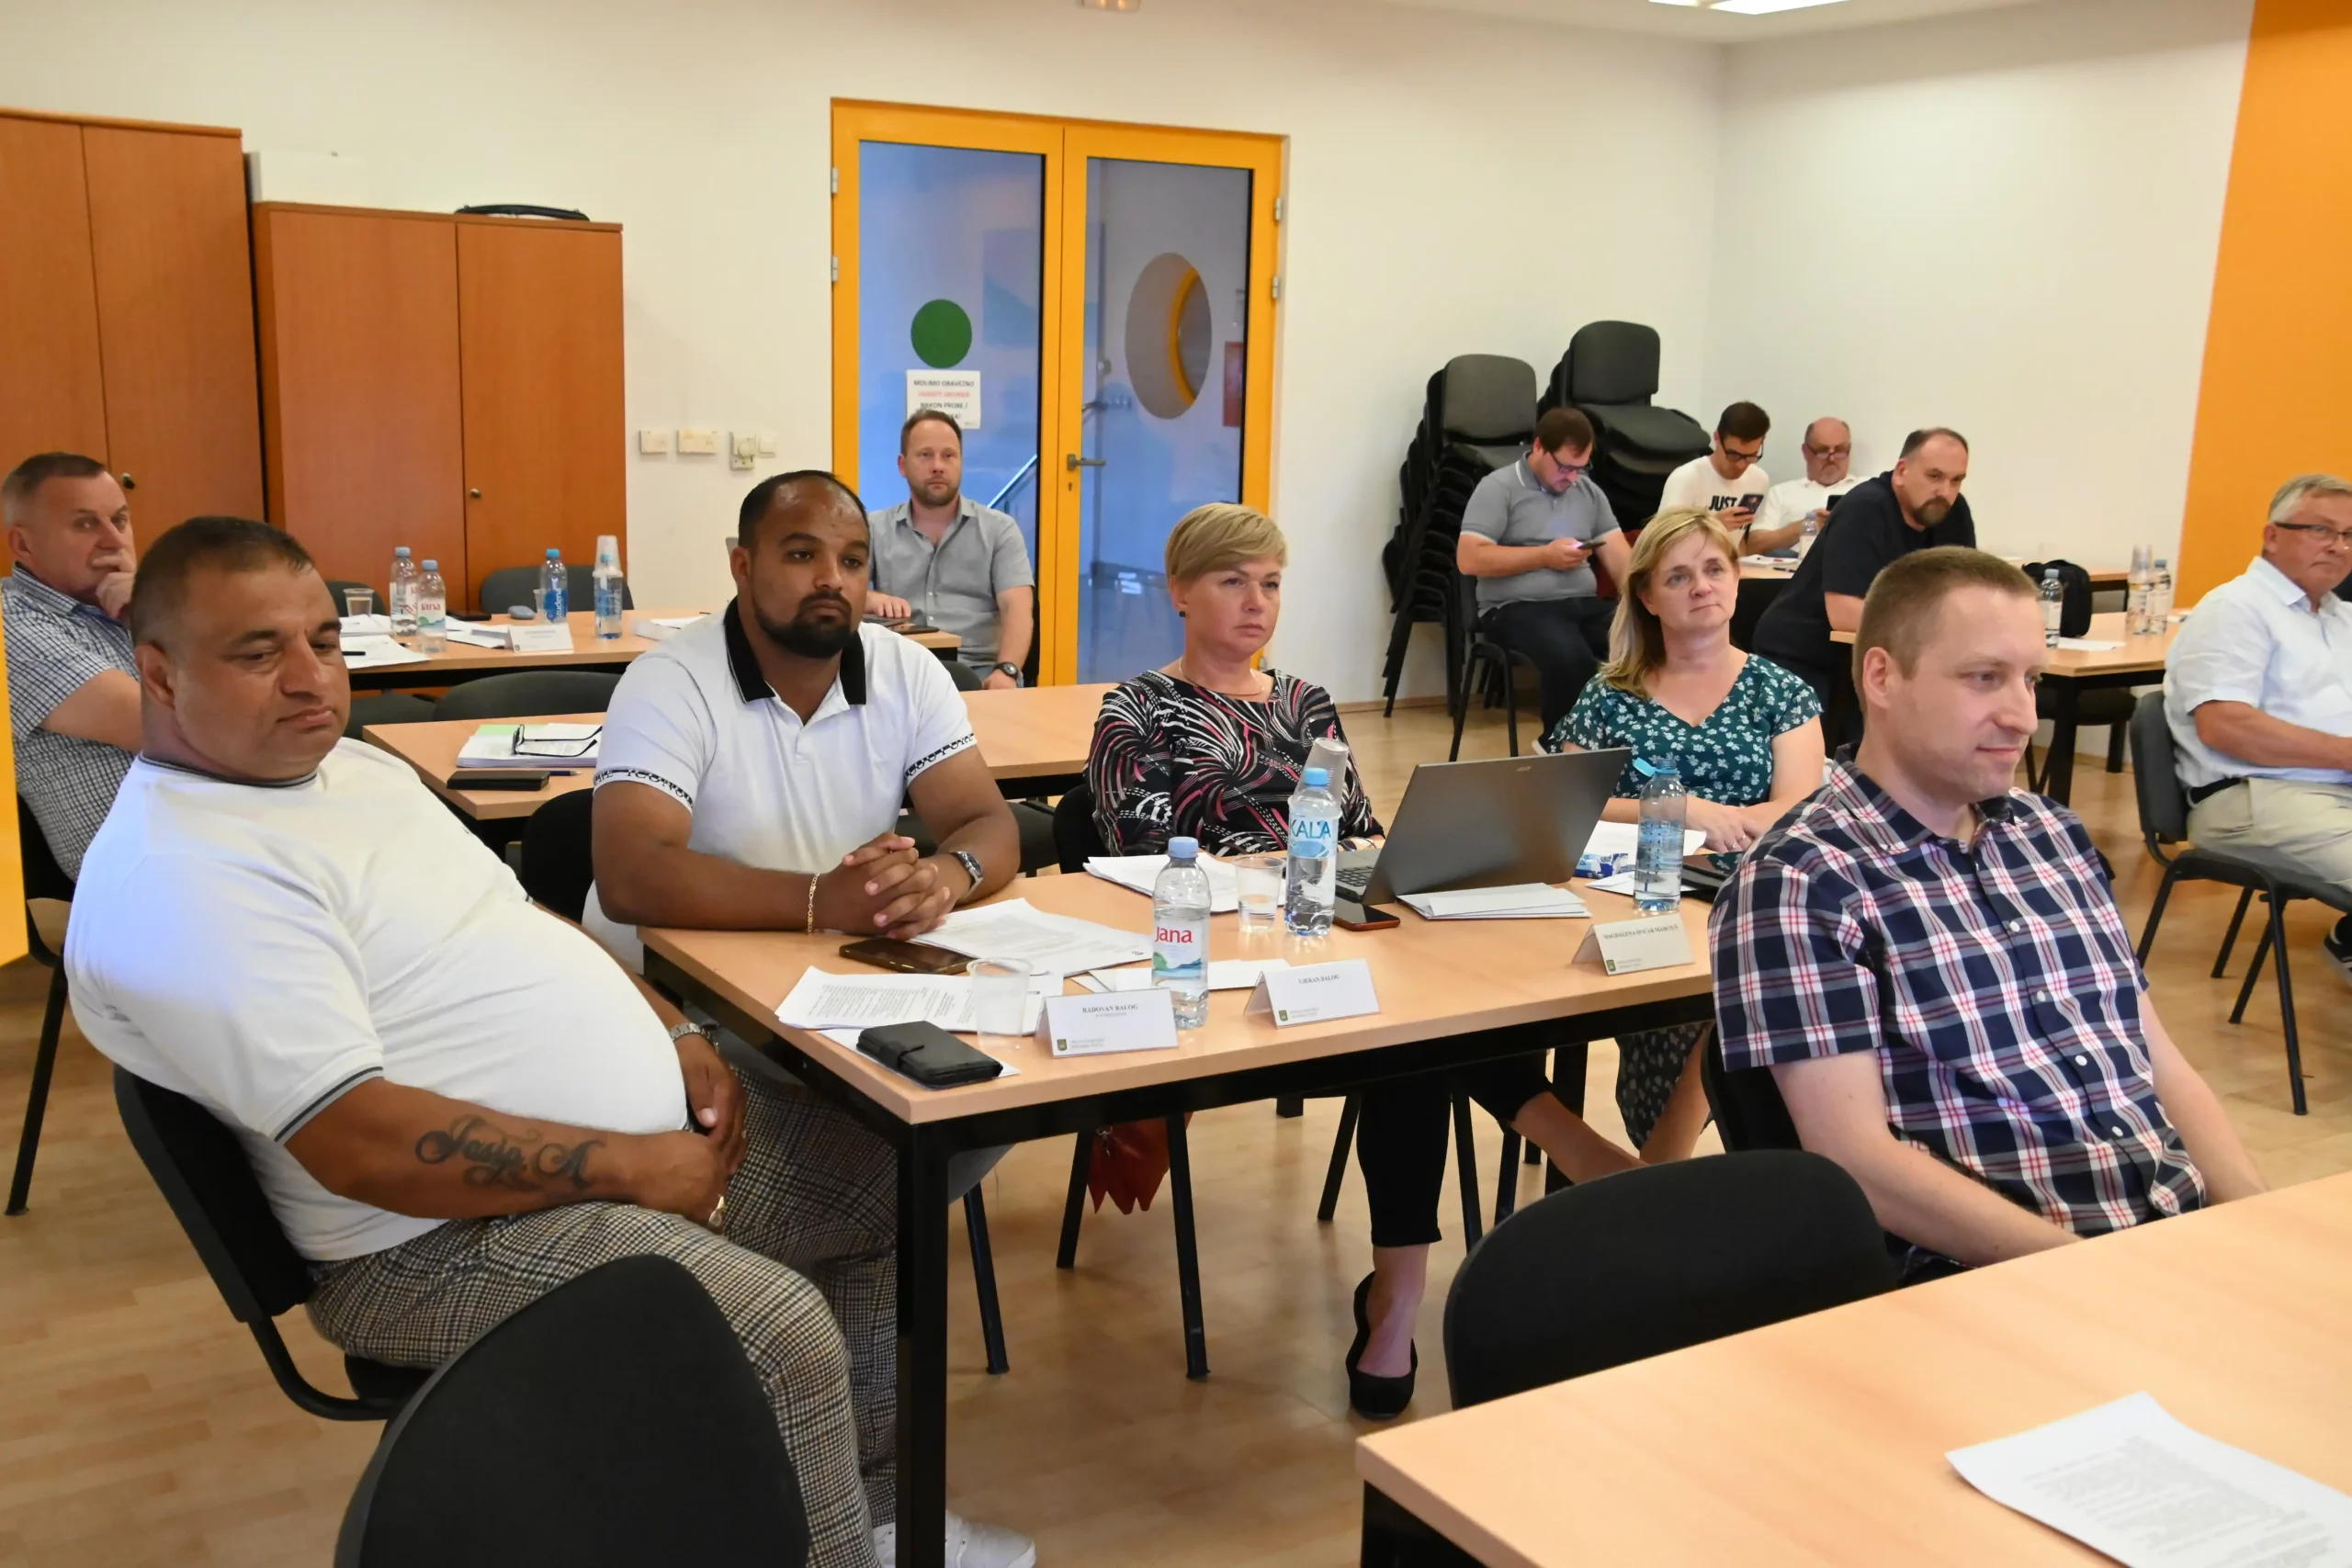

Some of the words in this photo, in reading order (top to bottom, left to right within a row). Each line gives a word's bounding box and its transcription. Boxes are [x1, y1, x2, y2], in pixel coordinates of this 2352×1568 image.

[1709, 495, 1737, 511] JUST
[1155, 926, 1193, 943] Jana
[1320, 974, 1340, 982] BALOG
[1082, 1005, 1114, 1013] RADOVAN
[1114, 1003, 1138, 1011] BALOG
